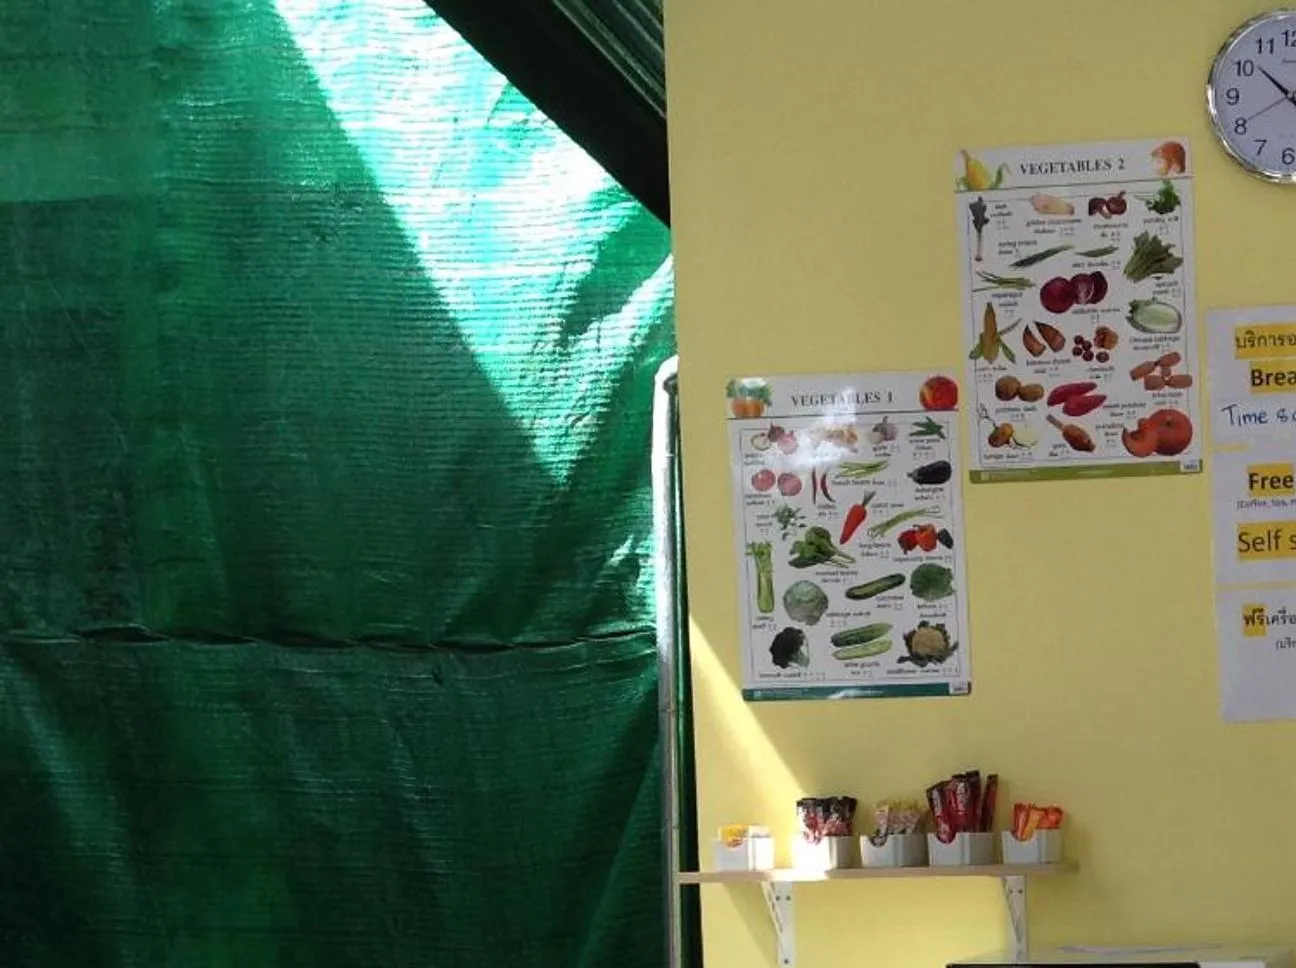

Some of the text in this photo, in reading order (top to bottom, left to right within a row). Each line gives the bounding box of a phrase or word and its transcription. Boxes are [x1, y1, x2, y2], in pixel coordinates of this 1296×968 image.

[1256, 38, 1275, 54] 11
[1235, 60, 1254, 77] 10
[1226, 88, 1240, 106] 9
[1234, 117, 1247, 135] 8
[1255, 139, 1268, 156] 7
[1282, 147, 1295, 165] 6
[1019, 157, 1127, 176] VEGETABLES 2
[790, 391, 881, 408] VEGETLES
[1222, 403, 1269, 427] Time
[1248, 472, 1295, 491] Free
[1237, 530, 1284, 553] Self
